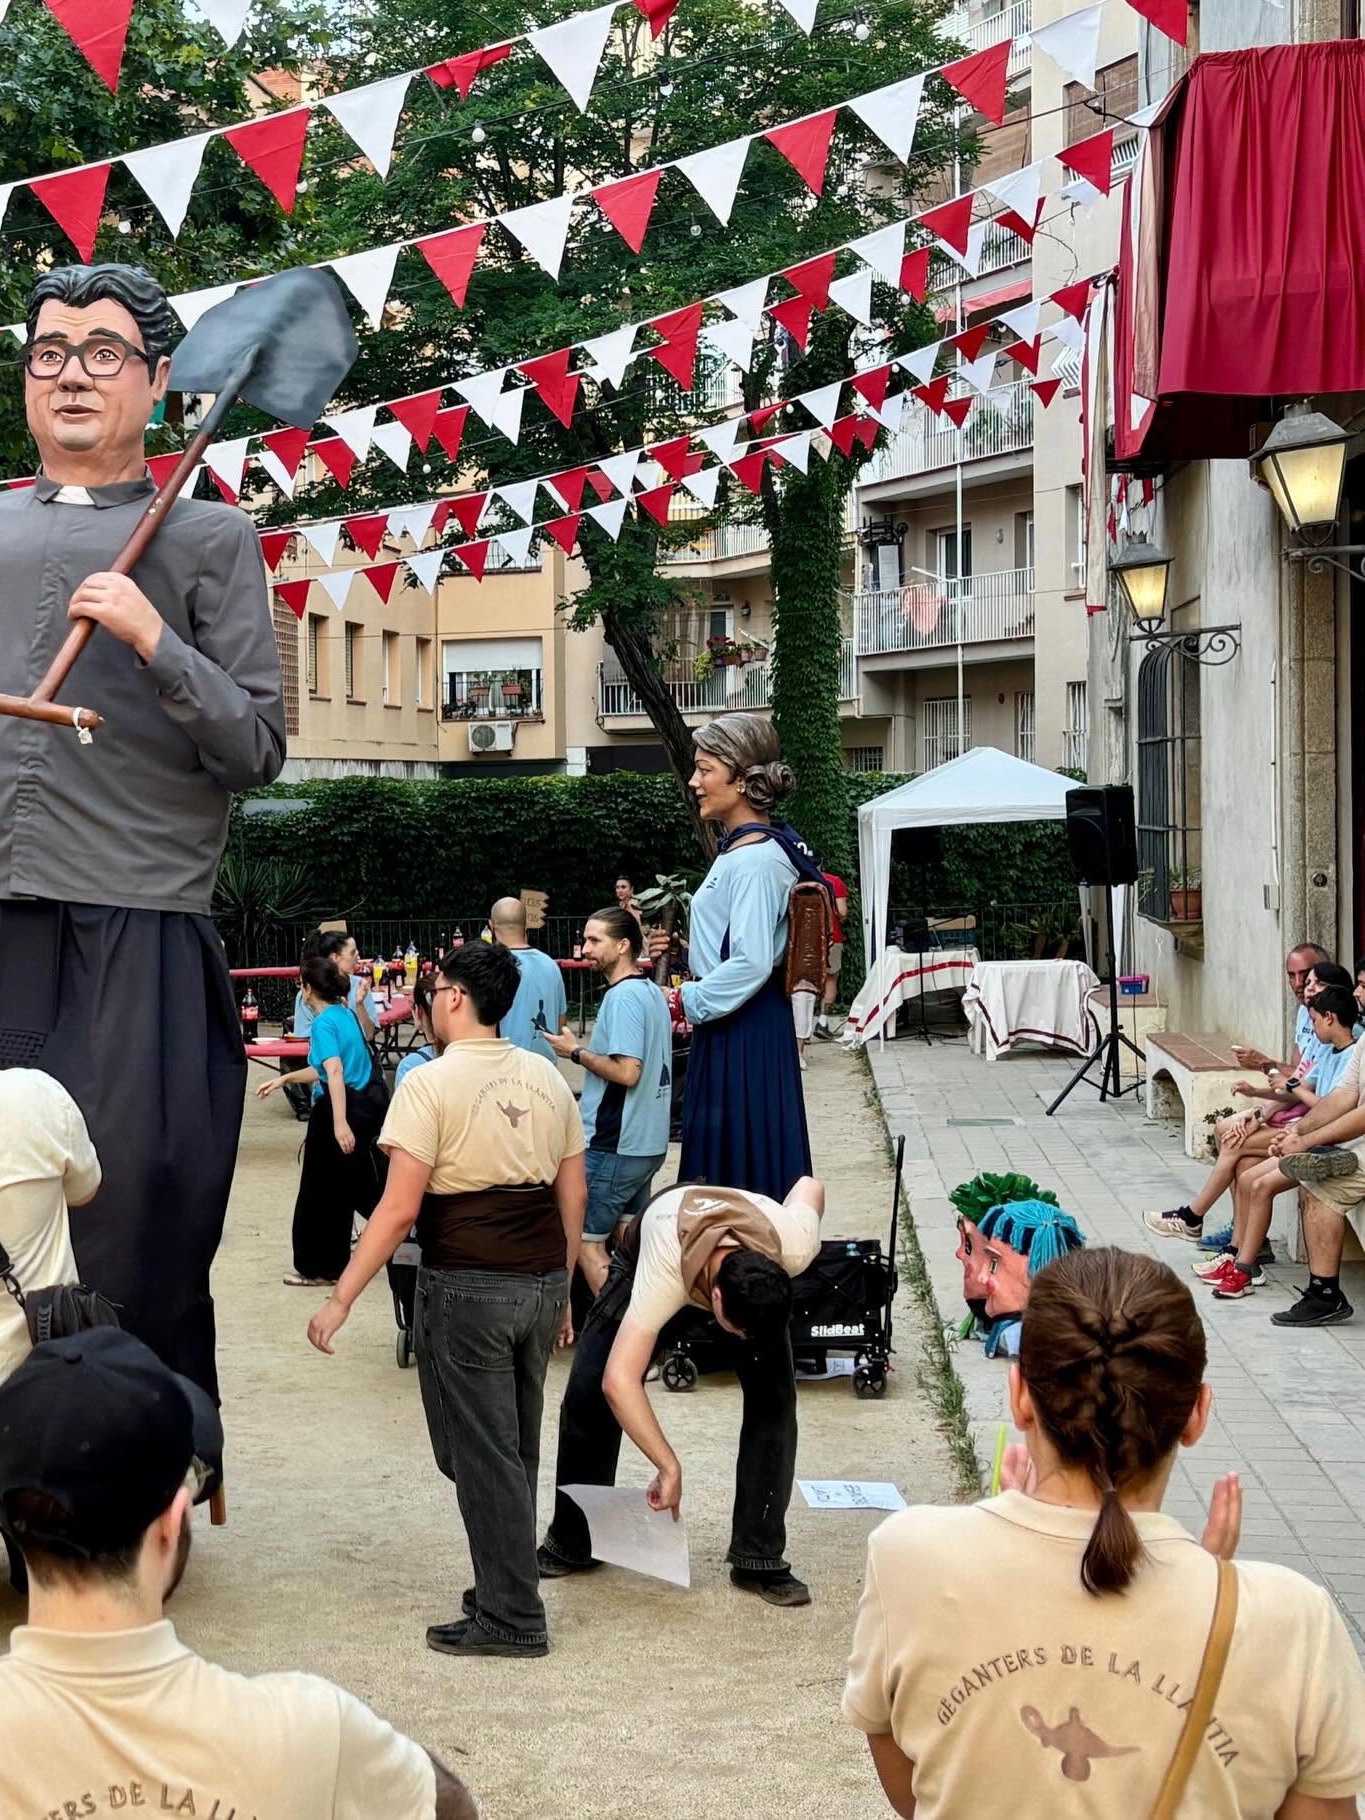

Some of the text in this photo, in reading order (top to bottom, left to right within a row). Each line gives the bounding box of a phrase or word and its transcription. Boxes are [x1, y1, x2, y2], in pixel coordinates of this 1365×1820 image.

[937, 1645, 1240, 1768] GEGANTERS DE LA LLATIA
[108, 1781, 146, 1809] DE
[160, 1783, 196, 1817] LA
